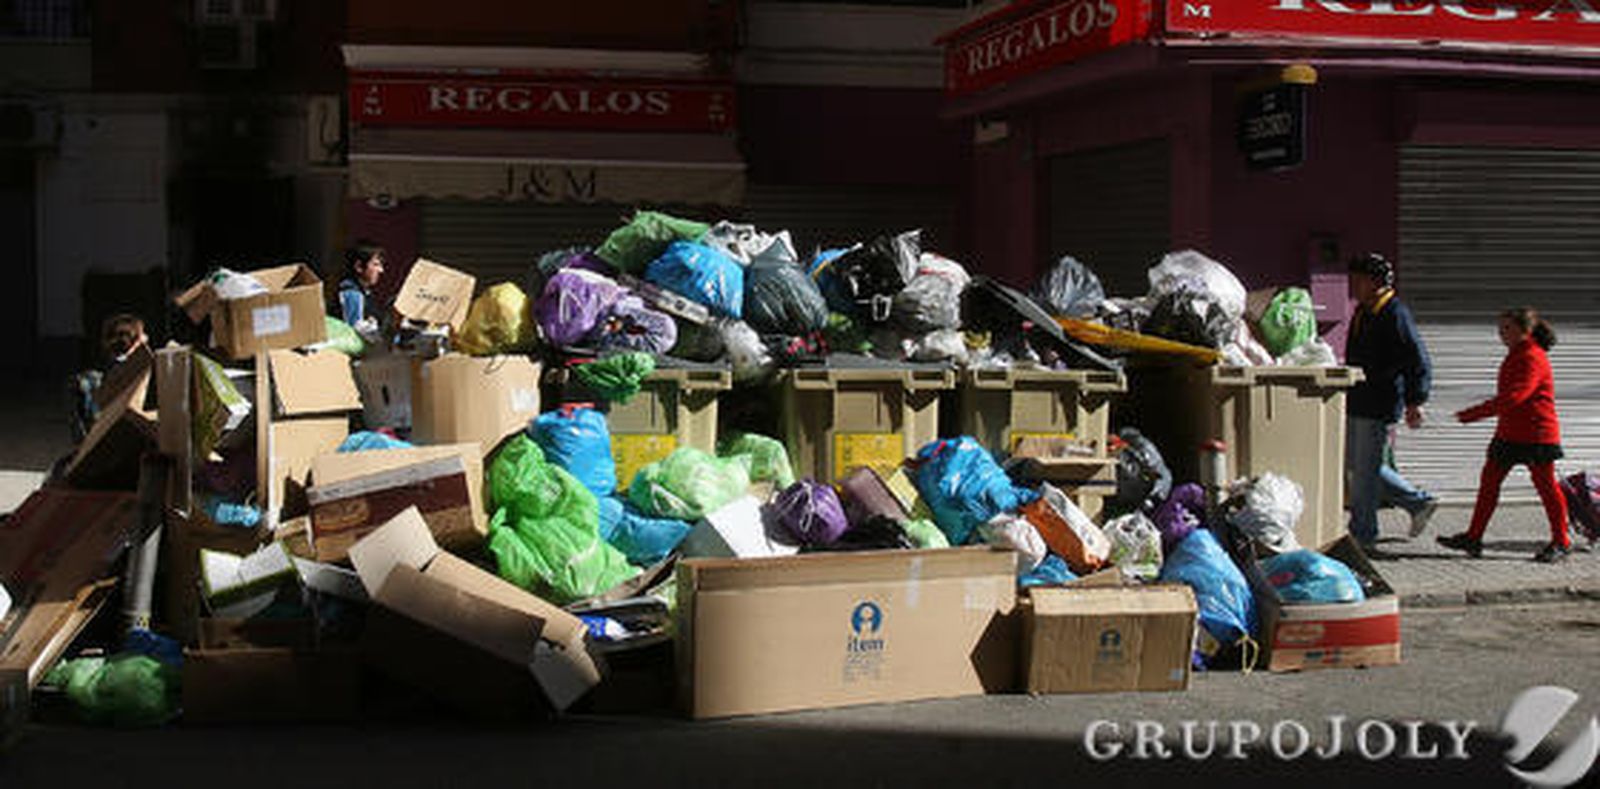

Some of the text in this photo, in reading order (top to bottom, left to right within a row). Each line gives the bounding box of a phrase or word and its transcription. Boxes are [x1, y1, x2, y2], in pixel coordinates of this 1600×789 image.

[965, 0, 1118, 76] REGALOS
[427, 85, 671, 116] REGALOS
[847, 636, 885, 653] item
